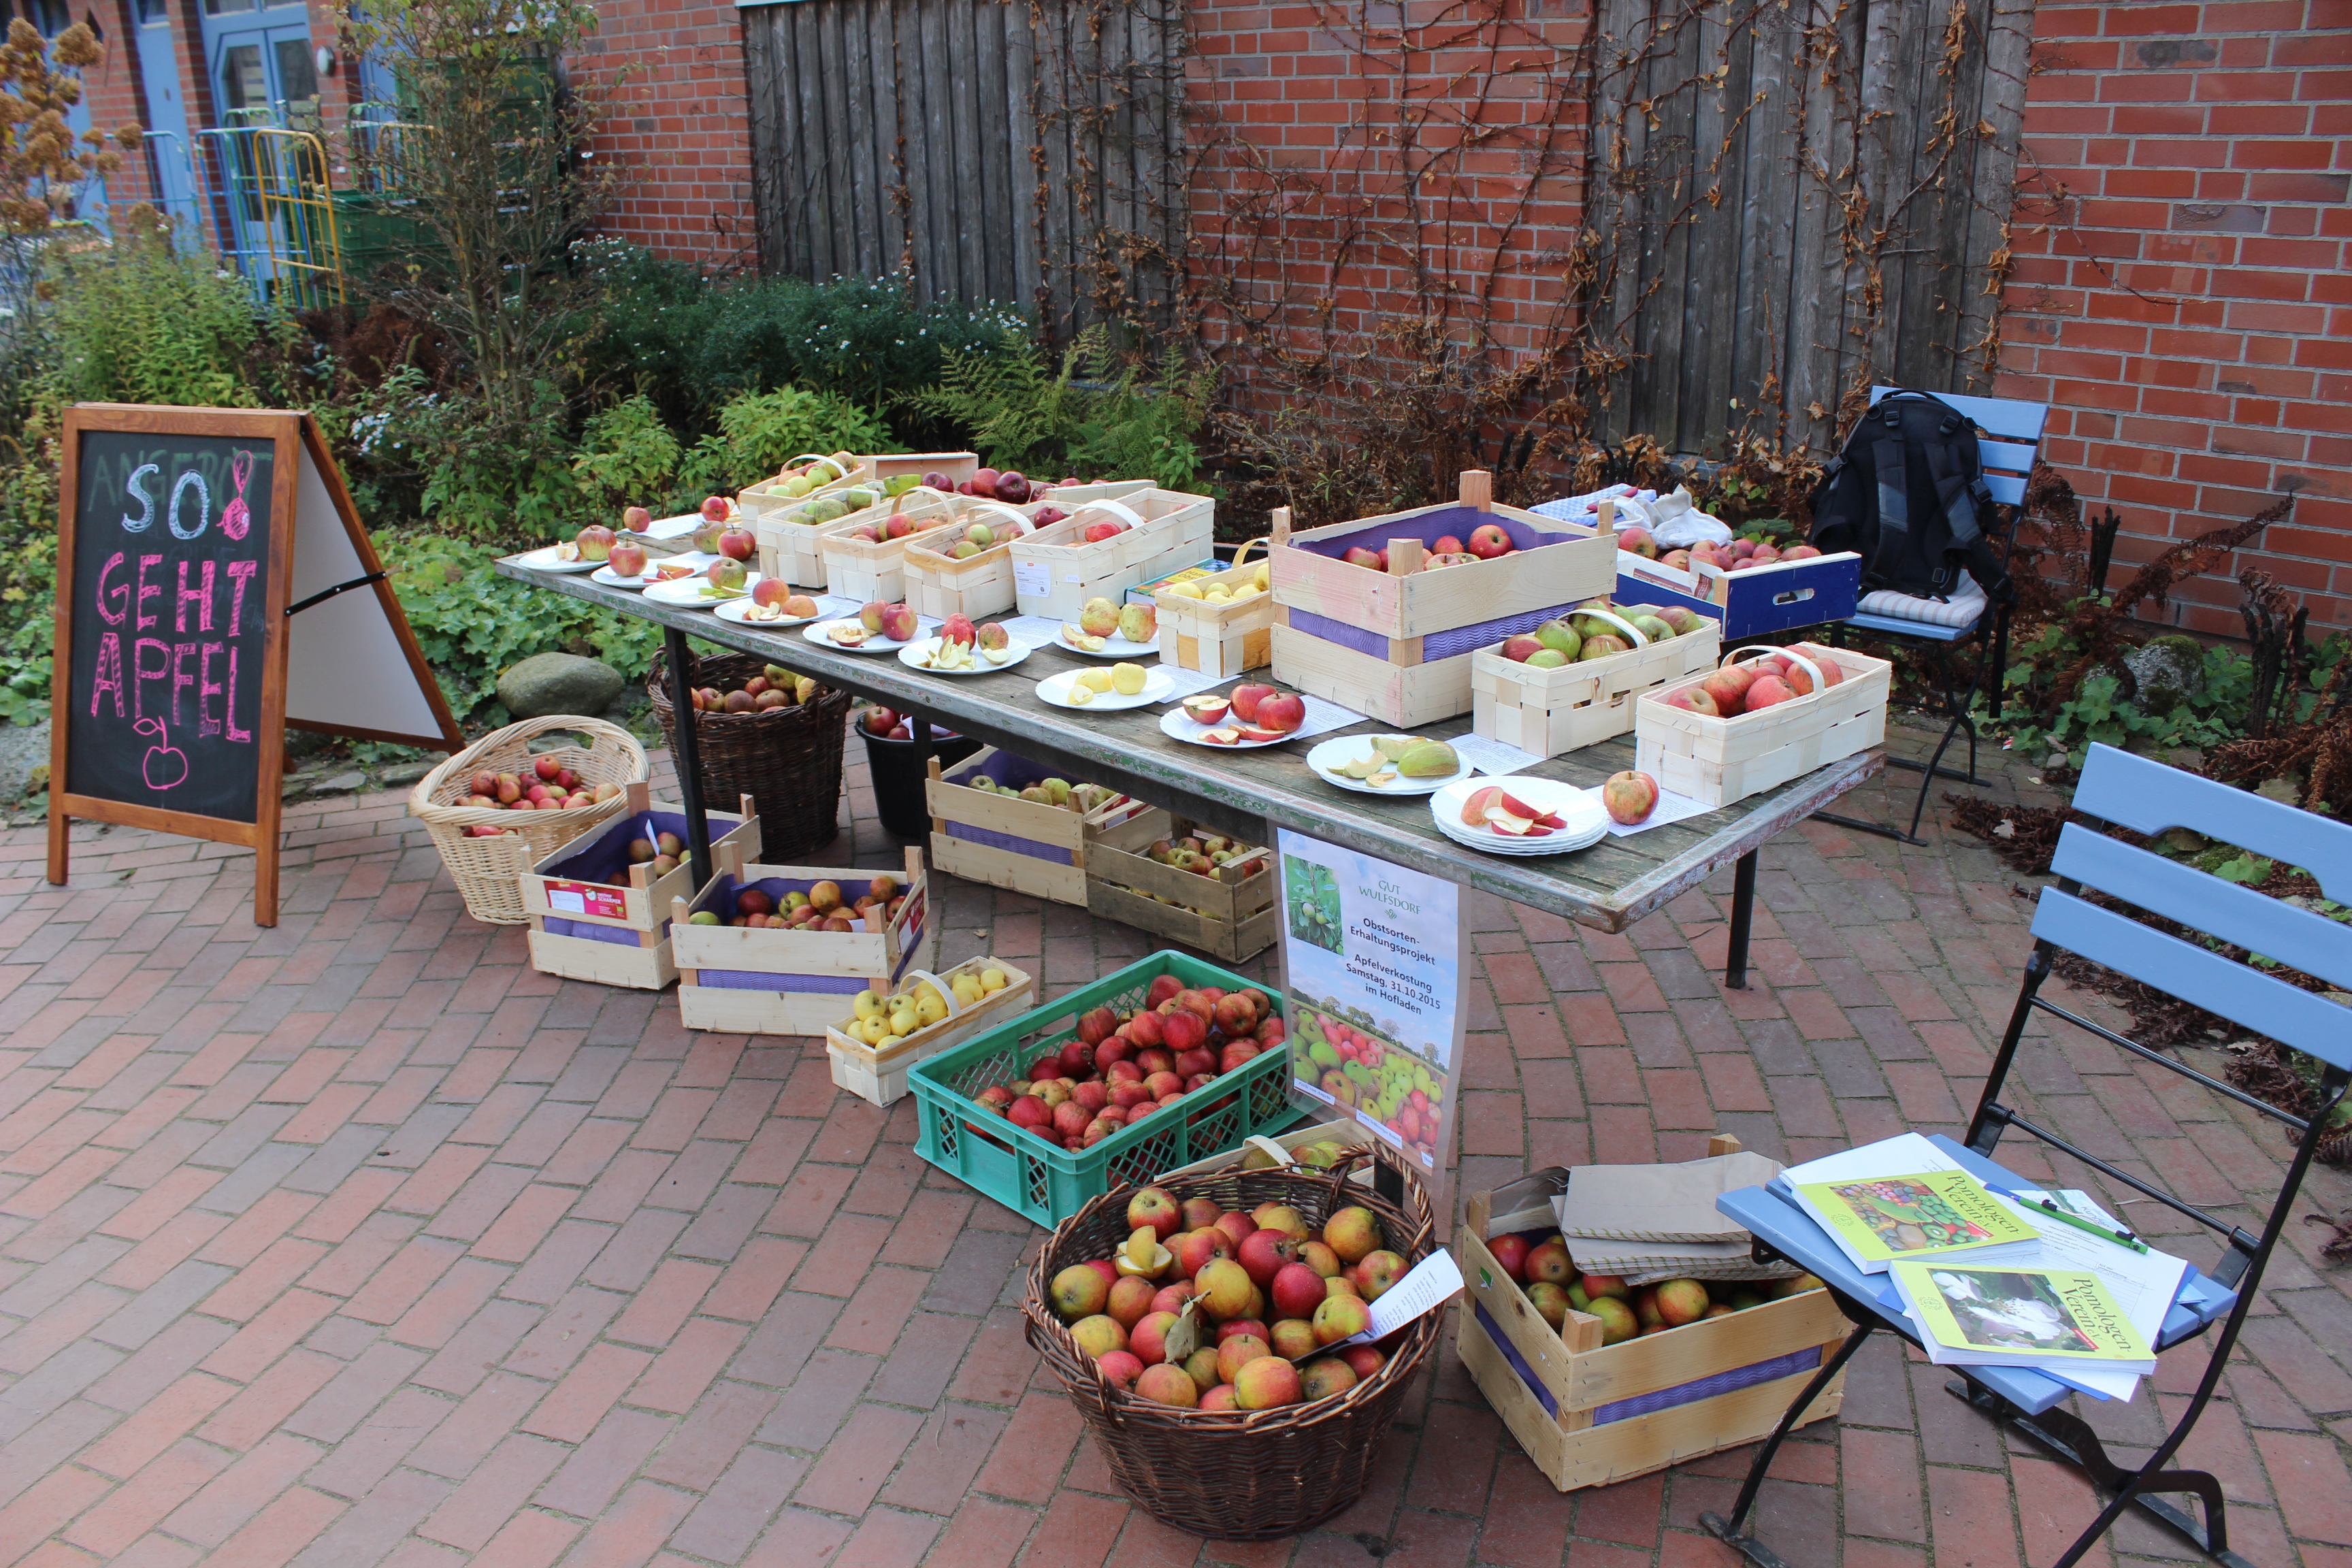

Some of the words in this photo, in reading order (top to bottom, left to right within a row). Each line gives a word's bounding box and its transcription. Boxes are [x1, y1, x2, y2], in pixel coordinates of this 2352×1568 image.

[96, 552, 257, 637] GEHT
[91, 632, 250, 742] APFEL
[1358, 885, 1421, 915] WULFSDORF
[1378, 880, 1401, 895] GUT
[1350, 926, 1435, 966] Erhaltungsprojekt
[1363, 918, 1420, 945] Obstsorten-
[1346, 963, 1388, 988] Samstag,
[1390, 981, 1441, 1010] 31.10.2015
[1354, 953, 1432, 994] Apfelverkostung
[1365, 983, 1377, 995] im
[1380, 989, 1422, 1015] Hofladen
[1942, 1185, 1982, 1220] Verein
[1945, 1175, 2020, 1235] Pomologen-
[2061, 1288, 2097, 1328] Verein
[2072, 1278, 2132, 1352] Pomologen-
